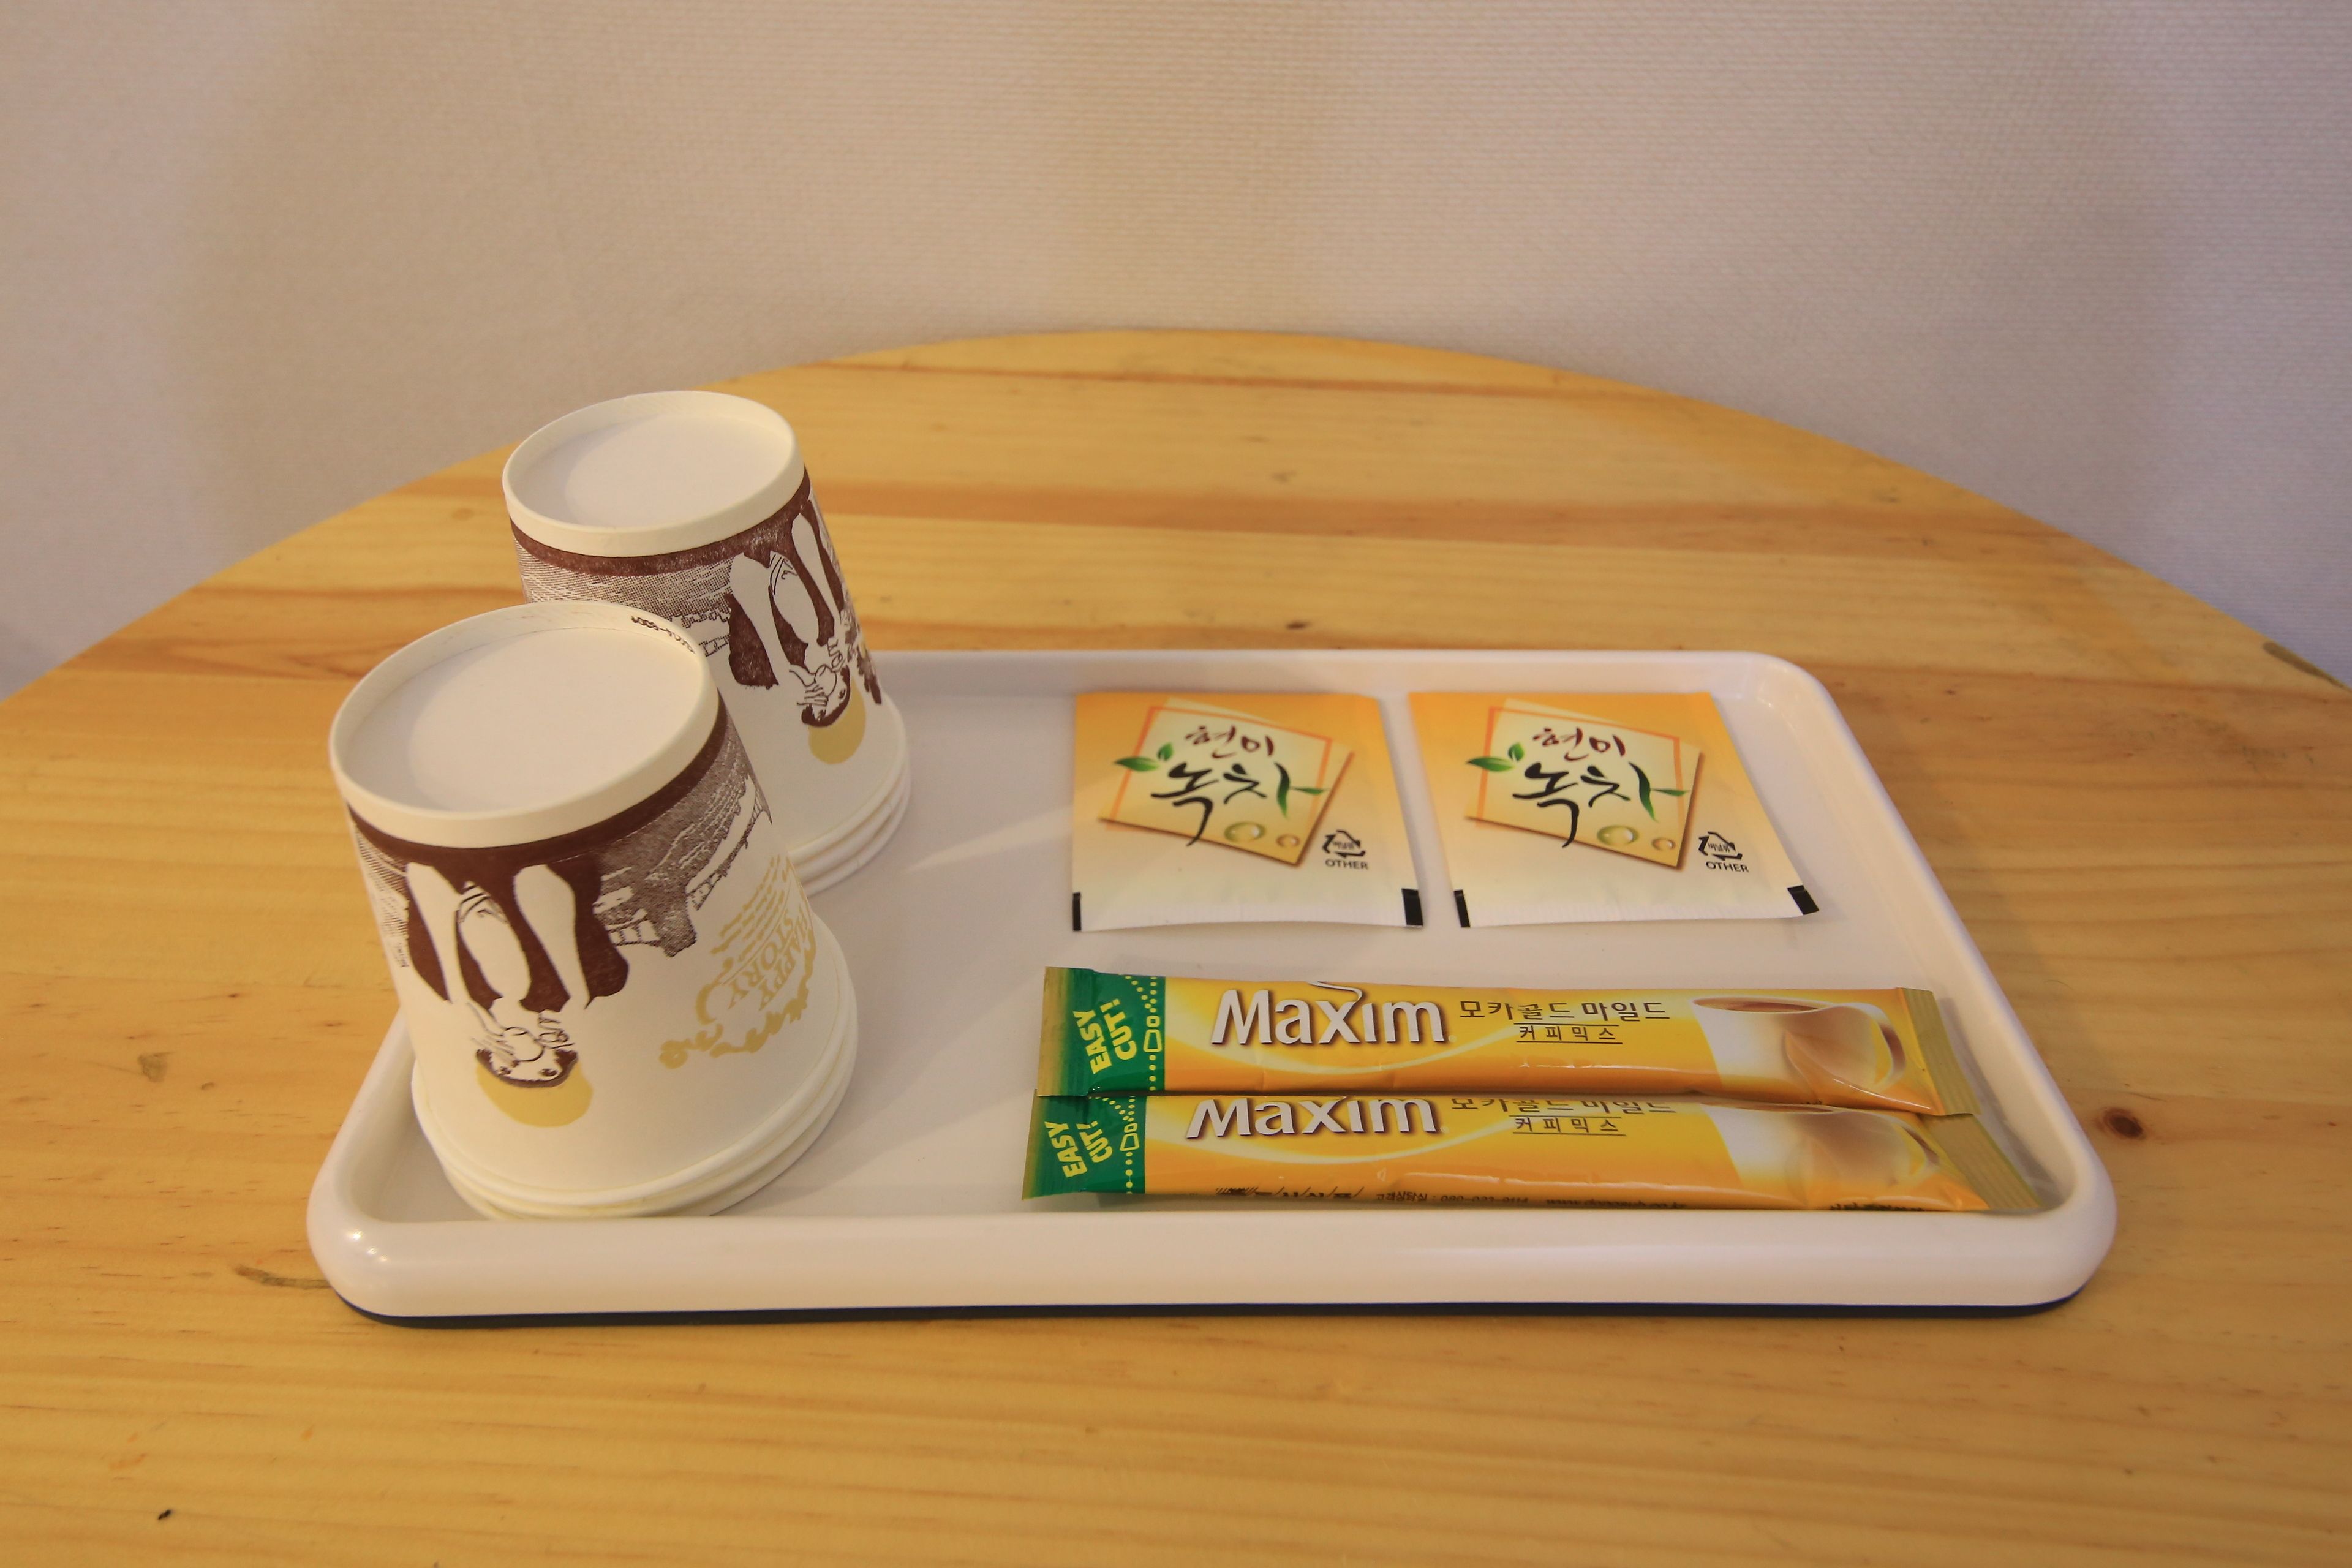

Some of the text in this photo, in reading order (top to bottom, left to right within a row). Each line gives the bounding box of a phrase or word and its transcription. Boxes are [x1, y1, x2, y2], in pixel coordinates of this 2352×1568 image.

[1185, 725, 1274, 758] 현미
[1532, 726, 1626, 761] 현미
[1151, 762, 1326, 846] 녹차
[1512, 761, 1689, 848] 녹차
[1325, 859, 1368, 870] OTHER
[1706, 861, 1749, 873] OTHER
[1100, 998, 1137, 1060] CUT!
[1211, 987, 1445, 1044] Maxim
[1460, 1001, 1670, 1022] 모카골드 마일드
[1519, 1025, 1616, 1041] 커피믹스
[1073, 1010, 1112, 1074] EASY
[1186, 1096, 1437, 1139] Maxim
[1515, 1117, 1618, 1133] 커피믹스
[1044, 1121, 1087, 1178] EASY
[1076, 1120, 1114, 1163] CUT!
